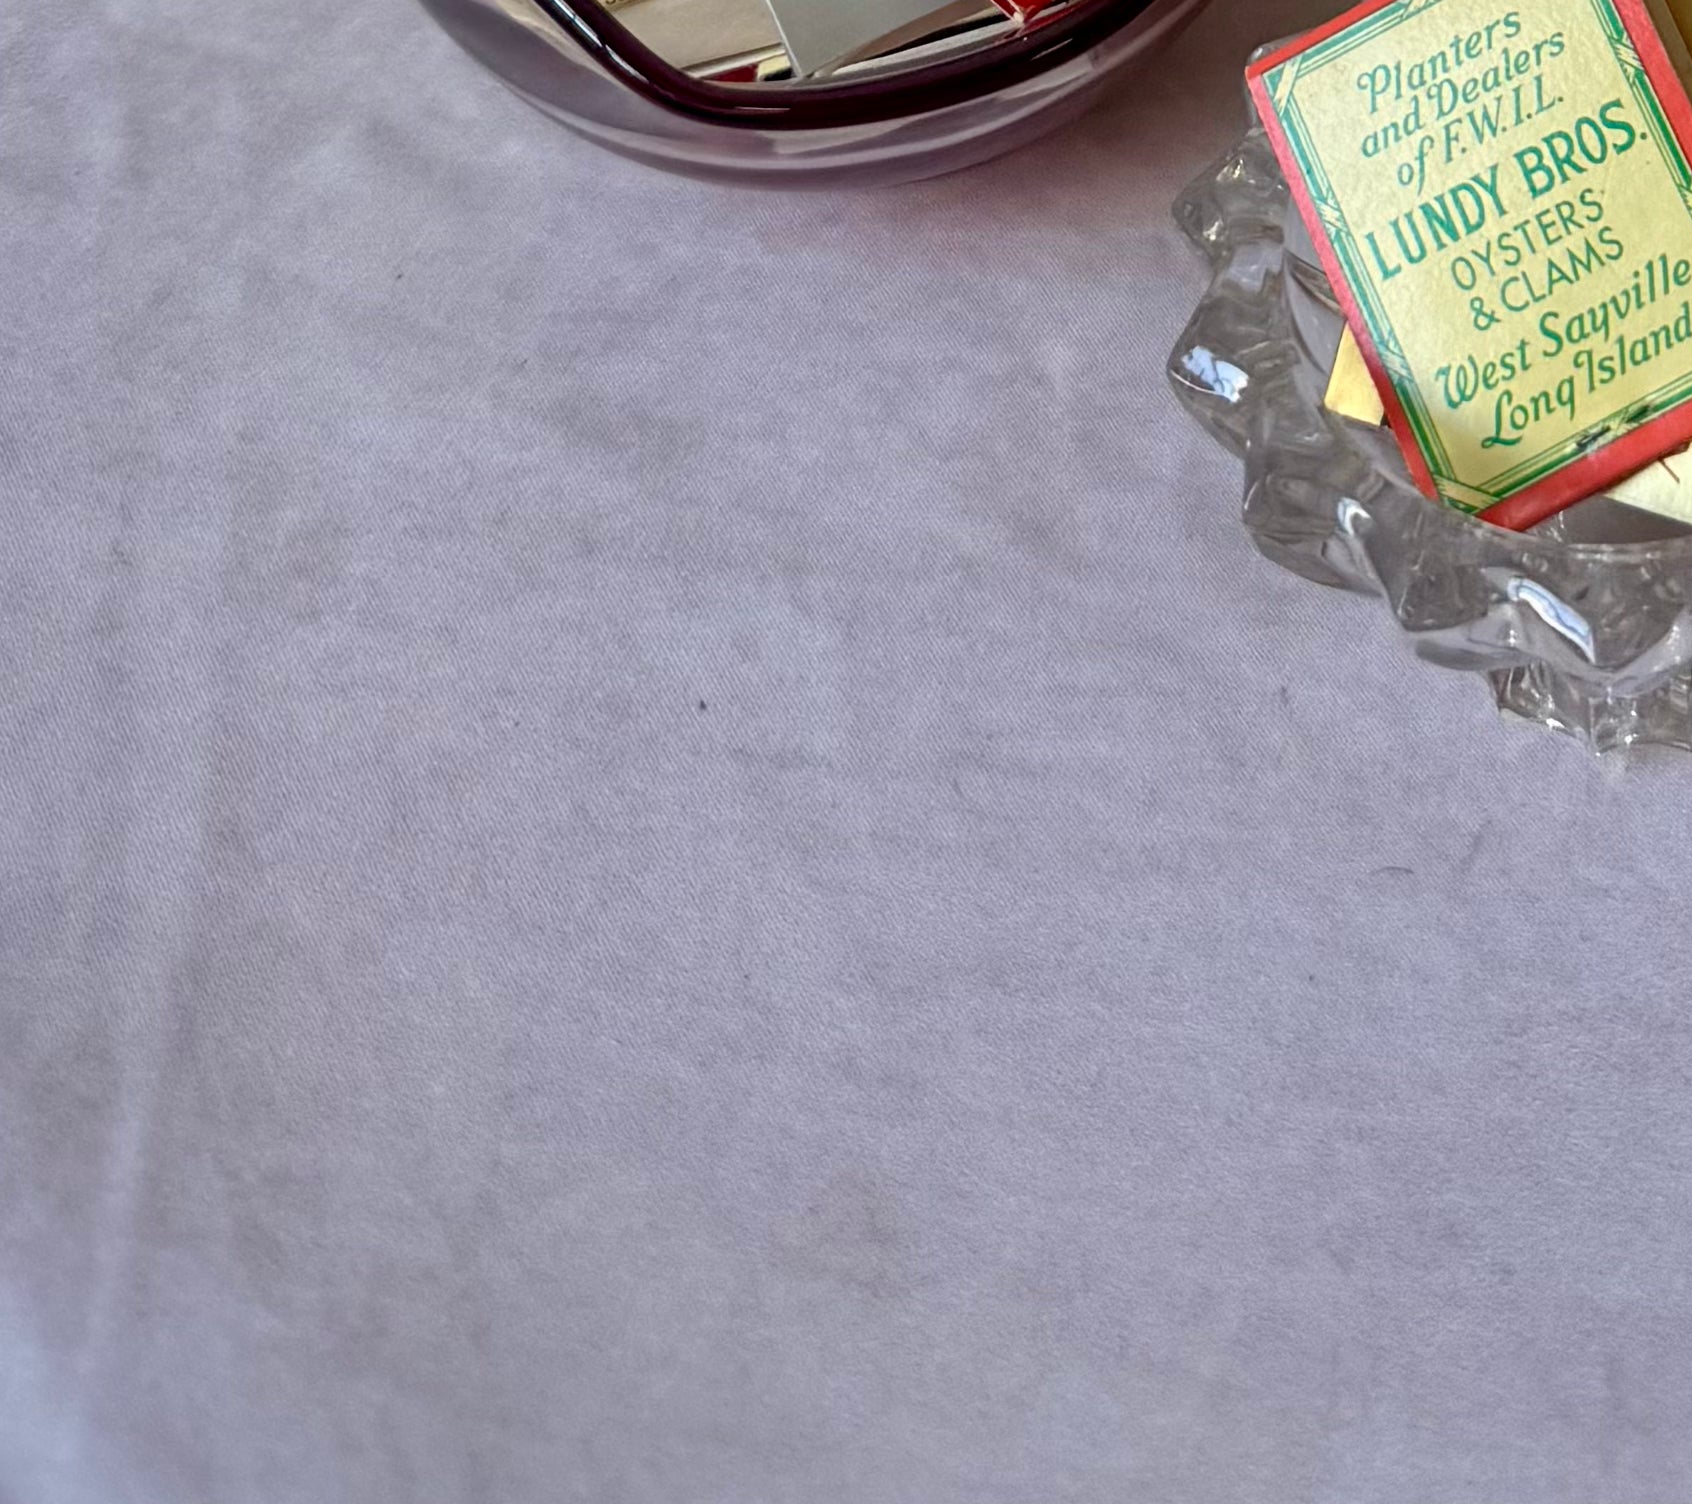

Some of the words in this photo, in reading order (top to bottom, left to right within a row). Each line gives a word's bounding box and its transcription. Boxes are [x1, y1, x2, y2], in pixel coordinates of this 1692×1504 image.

[1356, 8, 1524, 116] Planters
[1361, 104, 1425, 161] and
[1426, 29, 1567, 125] Dealers
[1362, 166, 1510, 283] LUNDY
[1515, 97, 1649, 204] BROS.
[1397, 142, 1436, 195] of
[1450, 186, 1607, 294] OYSTERS
[1499, 227, 1626, 316] CLAMS
[1434, 333, 1531, 412] West
[1479, 369, 1577, 454] Long
